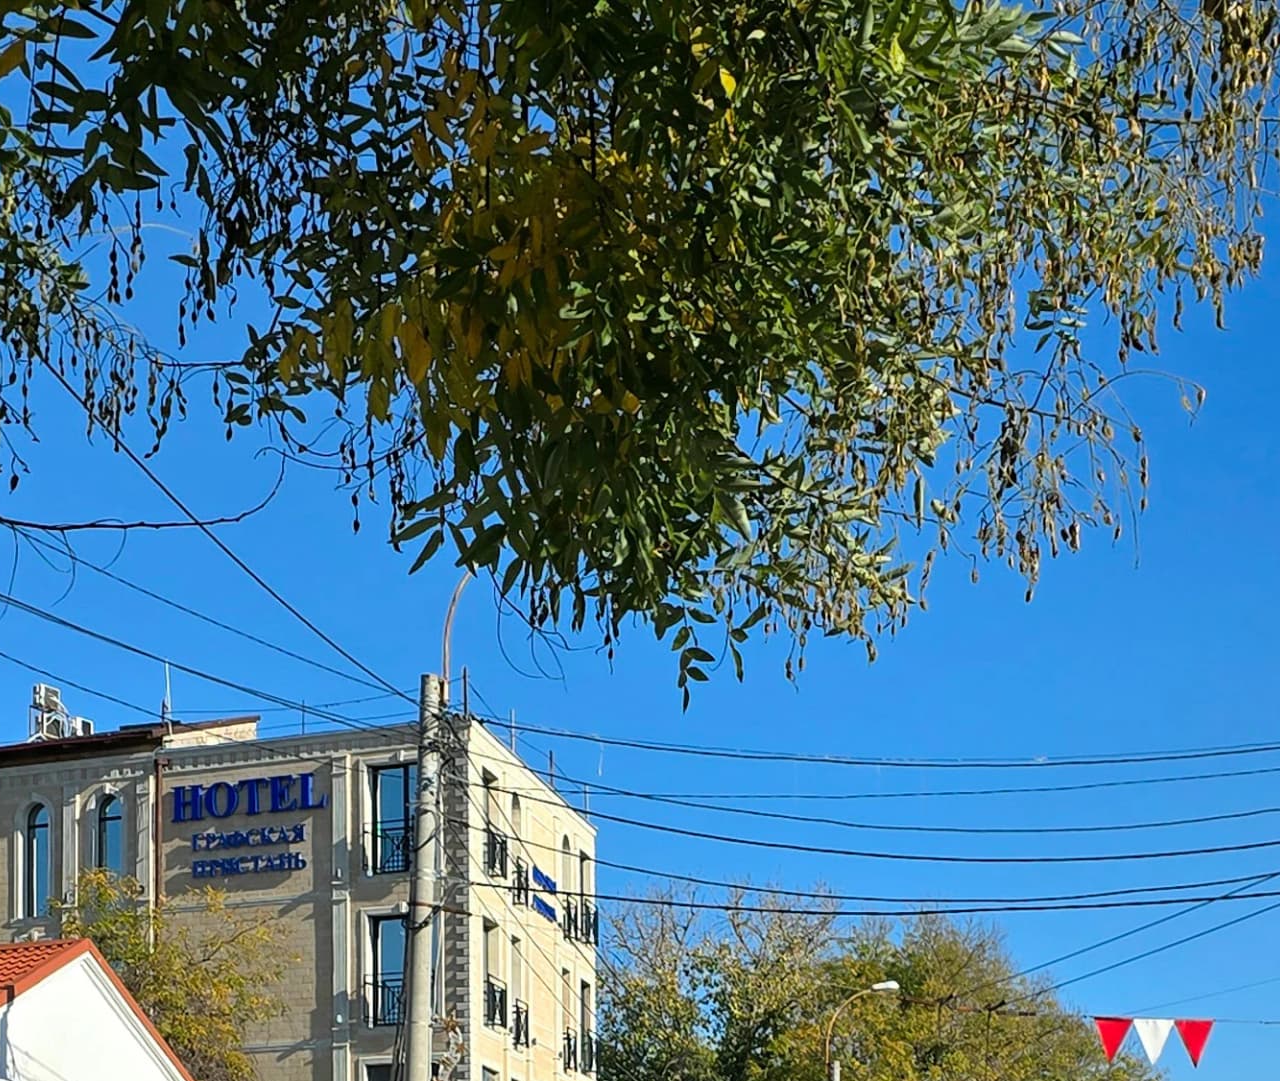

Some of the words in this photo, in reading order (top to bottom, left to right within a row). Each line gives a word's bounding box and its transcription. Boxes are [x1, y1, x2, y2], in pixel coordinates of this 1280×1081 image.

[171, 772, 328, 822] HOTEL
[192, 823, 306, 852] ГРАФСКАЯ
[192, 852, 308, 878] ПРИСТАНЬ
